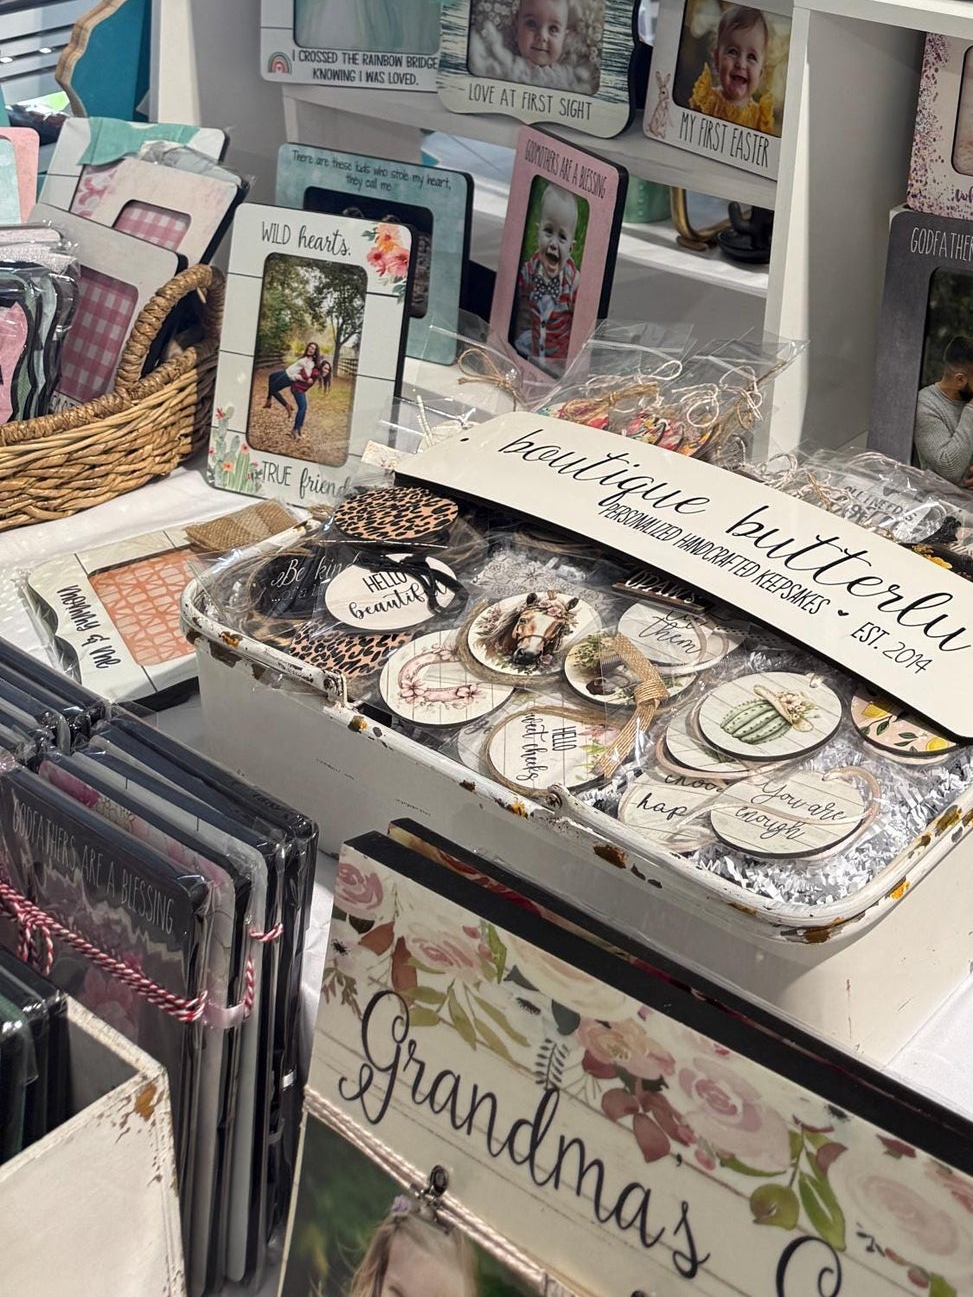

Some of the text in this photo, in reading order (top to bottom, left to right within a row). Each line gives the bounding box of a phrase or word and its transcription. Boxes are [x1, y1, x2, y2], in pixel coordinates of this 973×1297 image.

[298, 50, 438, 70] CROSSED THE RAINBOW BRIDGE
[312, 68, 419, 86] KNOWING WAS LOVED.
[468, 82, 593, 120] LOVE AT FIRST SIGHT
[680, 112, 770, 168] MY FIRST EASTER
[292, 150, 313, 164] There
[332, 160, 352, 170] these
[373, 166, 388, 177] who
[390, 168, 409, 182] stole
[412, 175, 425, 189] my
[346, 174, 363, 191] they
[525, 138, 608, 199] GODMOTHERS ARE BLESSING
[262, 221, 352, 256] WILD hearts.
[262, 460, 292, 486] TRUE
[498, 428, 710, 516] boutique
[598, 501, 934, 675] PERSONALIZED HANDCRAFTED KEEPSAKES EST. 2014
[56, 584, 101, 632] mommy
[89, 645, 122, 669] me
[552, 726, 577, 752] HELLO
[516, 743, 548, 781] cheeks
[736, 806, 807, 840] enough
[12, 800, 174, 935] GODFATHERS ARE A BLESSING
